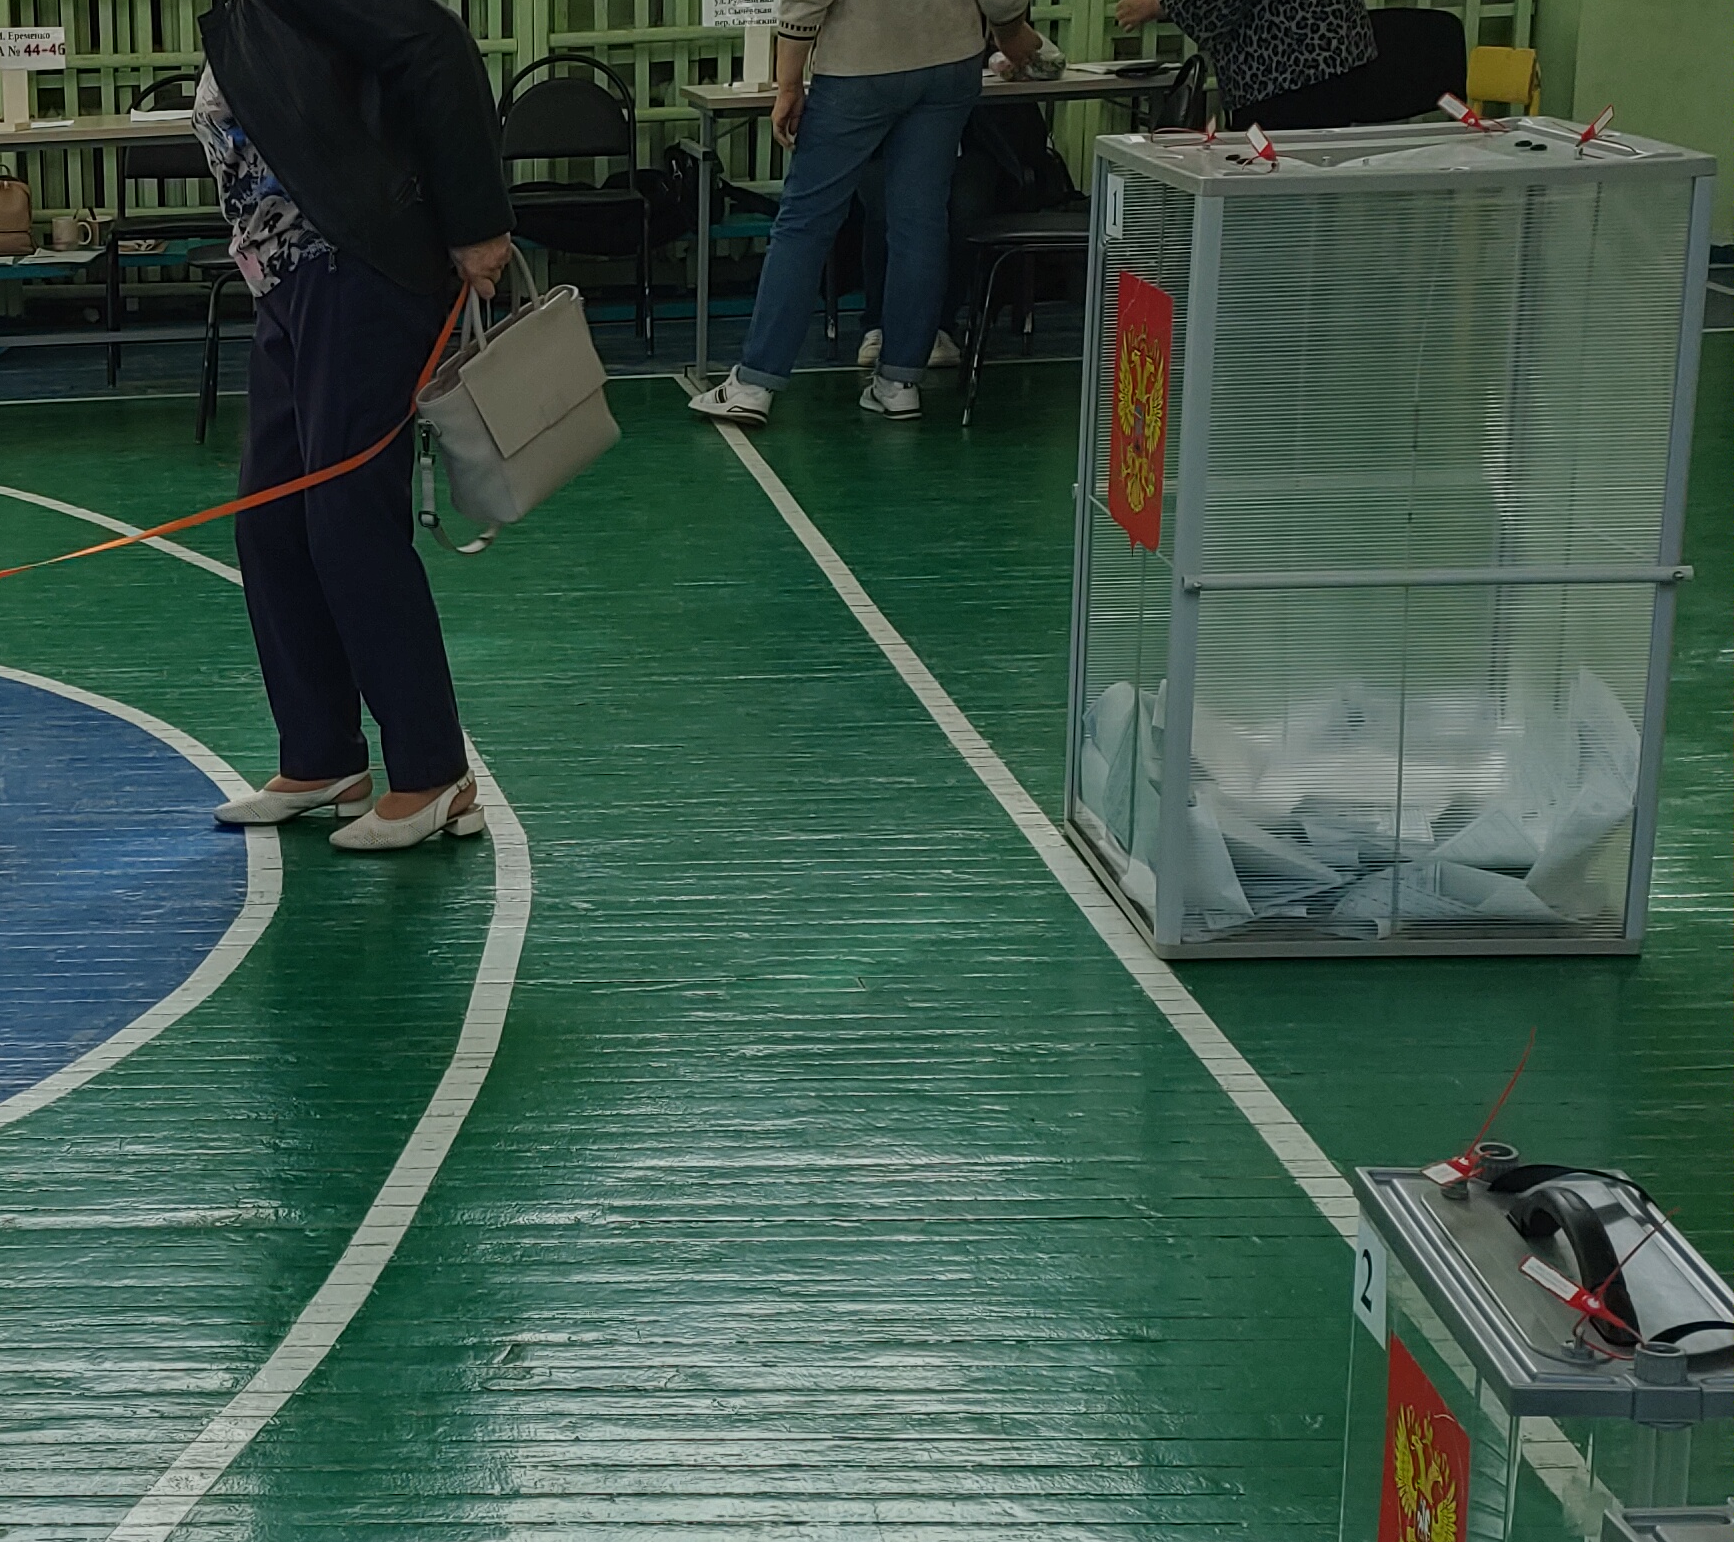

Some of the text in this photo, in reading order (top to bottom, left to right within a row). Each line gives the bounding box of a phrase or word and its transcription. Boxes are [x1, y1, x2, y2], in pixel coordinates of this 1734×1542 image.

[8, 32, 50, 43] Еременко
[23, 43, 65, 56] 44-46
[1112, 190, 1117, 227] 1
[1360, 1248, 1373, 1314] 2
